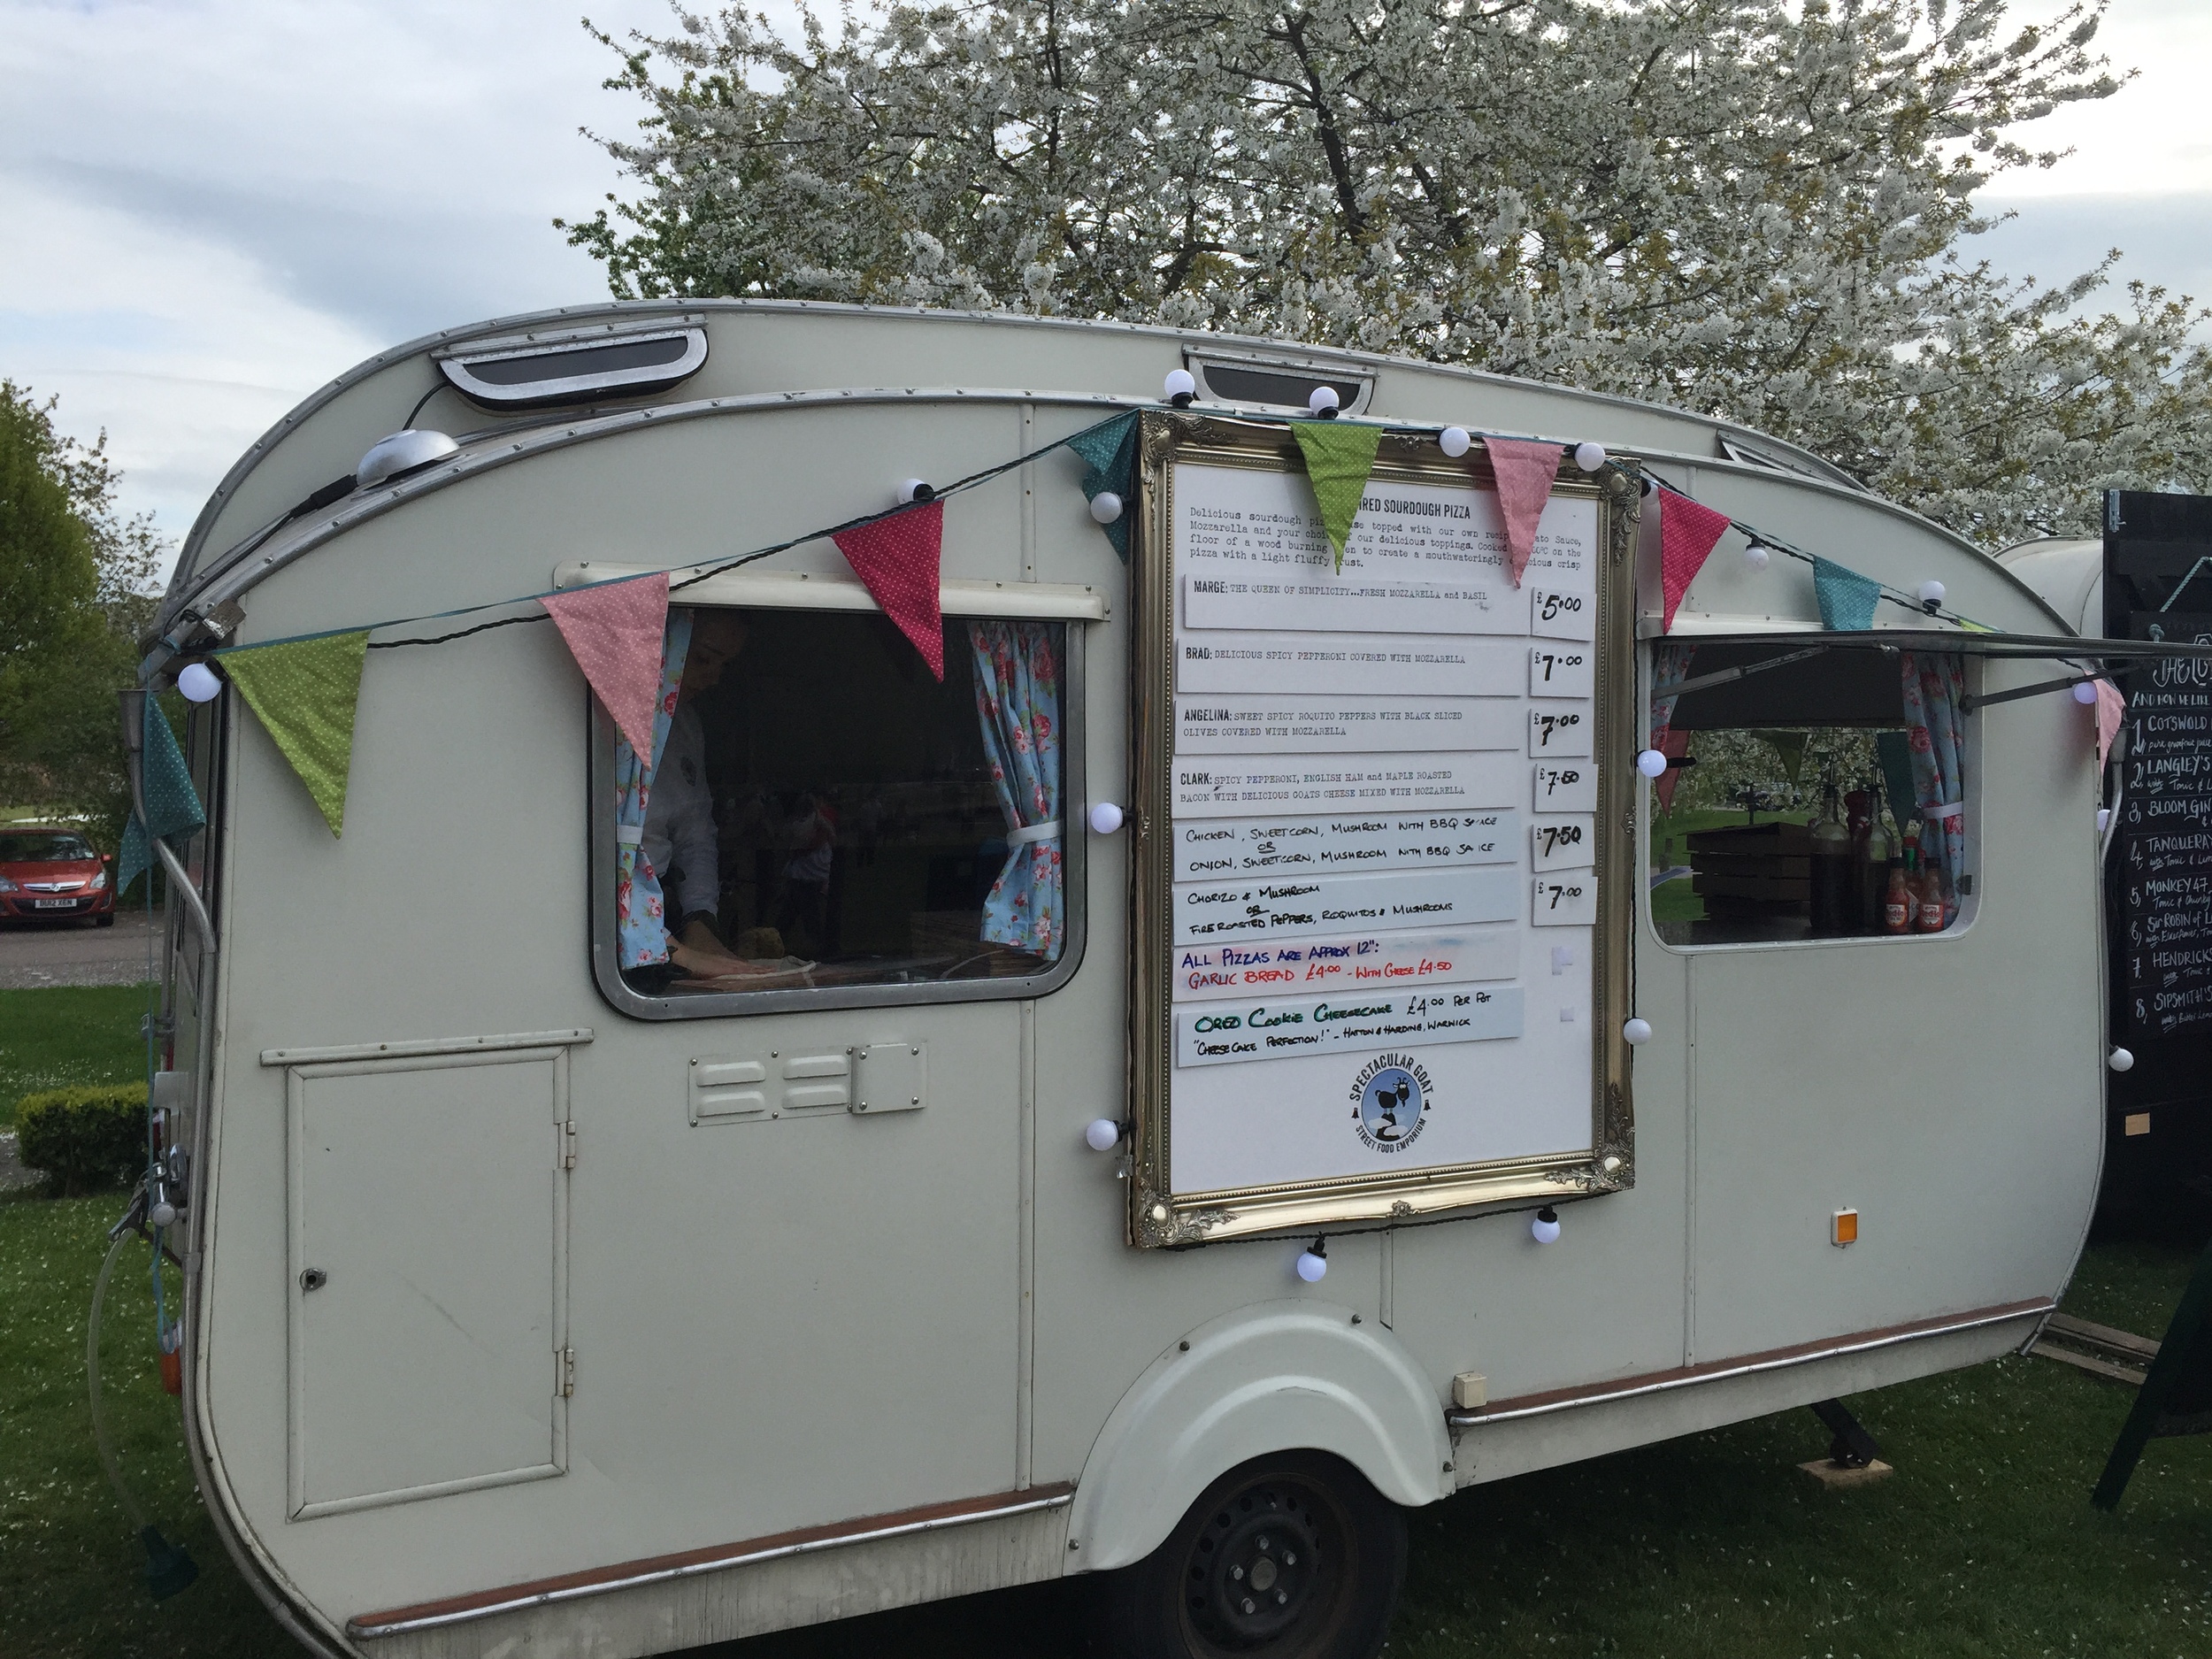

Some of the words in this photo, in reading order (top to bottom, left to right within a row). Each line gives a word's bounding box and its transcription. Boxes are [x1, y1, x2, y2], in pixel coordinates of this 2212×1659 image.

[1356, 496, 1381, 512] IRED
[1384, 498, 1441, 518] SOURDOUGH
[1444, 503, 1471, 519] PIZZA
[1189, 507, 1241, 519] Delicious
[1248, 513, 1302, 526] sourdough
[1372, 521, 1403, 533] topped
[1409, 525, 1432, 534] with
[1439, 527, 1455, 536] our
[1555, 535, 1582, 548] Sauce,
[1189, 520, 1248, 534] Mozzarella
[1254, 526, 1271, 535] and
[1277, 529, 1301, 538] your
[1356, 534, 1373, 543] our
[1379, 534, 1426, 547] delicious
[1430, 538, 1474, 552] toppings.
[1478, 541, 1508, 553] Cooked
[1552, 549, 1563, 557] on
[1567, 548, 1581, 557] the
[1189, 534, 1219, 545] floor
[1225, 537, 1238, 546] of
[1257, 540, 1281, 549] wood
[1287, 541, 1328, 555] burning
[1363, 547, 1373, 556] to
[1379, 549, 1409, 558] create
[1425, 552, 1503, 566] mouthwateringly
[1557, 560, 1582, 571] crisp
[1189, 549, 1217, 558] pizza
[1223, 549, 1247, 560] with
[1261, 552, 1290, 564] light
[1294, 555, 1331, 567] fluffy
[1340, 558, 1363, 568] rust.
[1194, 580, 1228, 594] MARGE:
[1230, 584, 1248, 593] THE
[1251, 585, 1280, 595] QUEEN
[1284, 586, 1295, 595] OF
[1389, 589, 1440, 599] MOZZARELLA
[1462, 592, 1488, 601] BASIL
[1186, 647, 1212, 660] BRAD:
[1215, 649, 1263, 659] DELICIOUS
[1265, 650, 1294, 660] SPICY
[1297, 651, 1347, 661] PEPPERONI
[1349, 653, 1386, 662] COVERED
[1389, 654, 1411, 663] WITH
[1415, 654, 1466, 664] MOZZARELLA
[2131, 691, 2154, 708] AND
[1184, 709, 1233, 722] ANGELINA:
[1233, 712, 1263, 721] SWEET
[1267, 712, 1294, 721] SPICY
[1298, 711, 1335, 722] ROQUITO
[1339, 711, 1376, 720] PEPPERS
[1379, 711, 1402, 720] WITH
[1404, 711, 1432, 720] BLACK
[1434, 711, 1463, 720] SLICED
[2147, 715, 2208, 732] COTSWOLD
[1183, 727, 1218, 737] OLIVES
[1221, 727, 1262, 736] COVERED
[1264, 727, 1288, 736] WITH
[1292, 726, 1347, 736] MOZZARELLA
[2147, 755, 2210, 778] LANGLEY'S
[1180, 772, 1213, 786] CLARK:
[1214, 775, 1242, 785] SPICY
[1246, 775, 1300, 785] PEPPERONI,
[1303, 773, 1342, 783] ENGLISH
[1345, 772, 1363, 782] HAM
[1367, 772, 1382, 781] and
[1386, 772, 1414, 780] MAPLE
[1417, 771, 1452, 780] ROASTED
[1180, 794, 1210, 803] BACON
[1214, 793, 1238, 802] WITH
[1241, 791, 1289, 801] DELICIOUS
[1293, 790, 1321, 800] GOATS
[1324, 789, 1356, 799] CHEESE
[1359, 788, 1386, 797] MIXED
[1390, 787, 1411, 796] WITH
[1415, 786, 1465, 795] MOZZARELLA
[2147, 800, 2187, 817] BLOOM
[1332, 822, 1387, 834] MUSHROOM
[1398, 821, 1424, 832] WITH
[1430, 818, 1459, 831] BBQ
[1257, 841, 1277, 854] OR
[1189, 856, 1238, 872] ONION,
[1321, 849, 1387, 864] MUSHROOM
[1398, 848, 1422, 858] WITH
[1426, 846, 1450, 856] BBQ
[1187, 892, 1238, 905] CHORIZO
[1258, 885, 1321, 900] MUSHROOM
[2146, 877, 2192, 896] MONKEY
[2193, 877, 2208, 893] 47
[1271, 913, 1317, 929] PEPPERS,
[1322, 909, 1377, 921] ROQUITOS
[1393, 902, 1454, 916] MUSHROOMS
[2164, 910, 2192, 928] ROBIN
[2193, 910, 2202, 927] of
[1181, 952, 1212, 970] ALL
[1222, 948, 1271, 967] PIZZAS
[1277, 949, 1302, 963] ARE
[1308, 945, 1351, 961] APPROX
[1188, 971, 1238, 991] GARLIC
[1244, 969, 1294, 984] BREAD
[1305, 963, 1341, 981] £4.00
[1356, 965, 1381, 979] WITH
[1384, 962, 1416, 979] CHEESE
[1417, 958, 1453, 976] £4.50
[1313, 1002, 1393, 1023] CHEESECAKE
[1407, 995, 1445, 1018] £4.00
[1454, 995, 1471, 1007] PER
[1476, 991, 1493, 1003] POT
[1342, 1026, 1374, 1039] HATTON
[1427, 1018, 1471, 1031] WARWICK
[1349, 1053, 1415, 1102] SPECTACULAR
[1413, 1064, 1434, 1094] GOAT
[1356, 1125, 1377, 1150] STREET
[1377, 1143, 1394, 1154] FOOD
[1396, 1118, 1426, 1152] EMPORIUM
